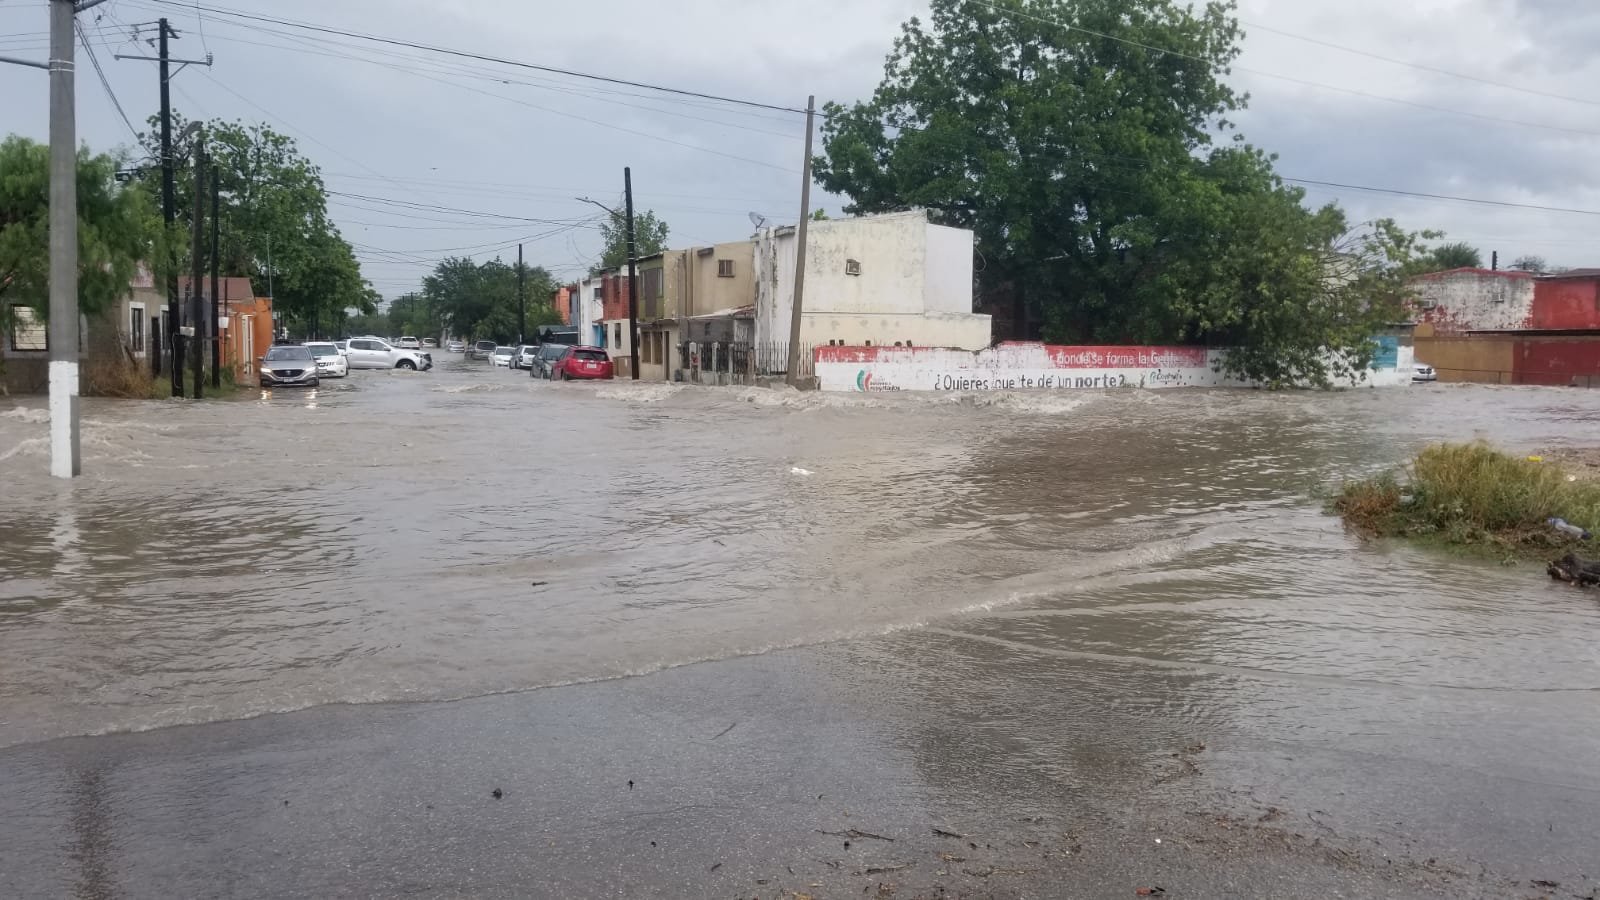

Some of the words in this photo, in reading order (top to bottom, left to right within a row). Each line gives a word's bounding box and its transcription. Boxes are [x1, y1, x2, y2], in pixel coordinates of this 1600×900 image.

[1106, 352, 1134, 365] forma
[1138, 352, 1147, 364] la
[934, 374, 988, 390] ¿Quieres
[1021, 374, 1033, 388] te
[1075, 373, 1125, 388] norte?
